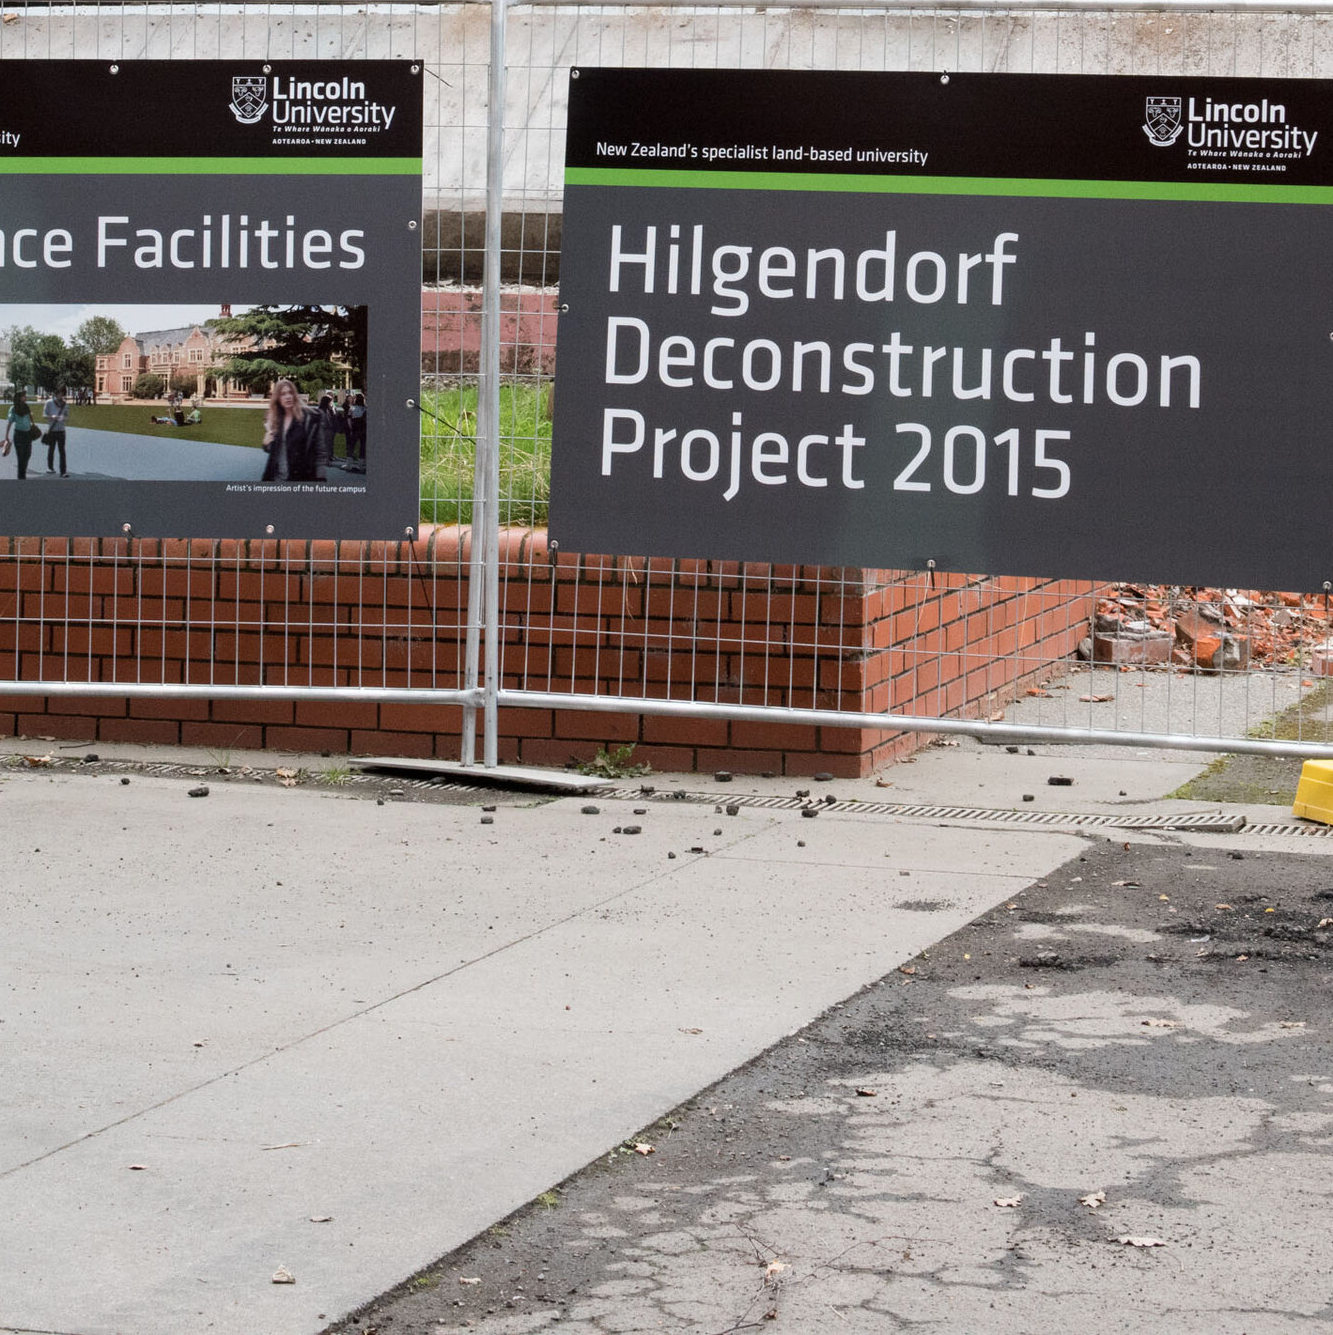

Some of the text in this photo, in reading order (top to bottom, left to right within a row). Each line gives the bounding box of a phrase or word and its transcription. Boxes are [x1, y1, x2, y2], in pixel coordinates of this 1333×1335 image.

[272, 76, 365, 100] Lincoln
[272, 100, 396, 130] University
[1188, 97, 1285, 123] Lincoln
[272, 125, 282, 133] Te
[283, 125, 310, 133] Whare
[353, 125, 381, 133] Aoraki
[1187, 122, 1318, 156] University
[597, 142, 928, 166] New Zealand’s specialist land-based university
[1186, 162, 1287, 172] AOTEAROA NEW ZEALAND
[1187, 149, 1198, 157] Te
[1199, 149, 1227, 157] Whare
[1272, 151, 1302, 159] Aoraki
[98, 214, 364, 269] Facilities
[608, 224, 1019, 317] Hilgendorf
[604, 316, 1201, 410] Deconstruction
[602, 408, 1070, 501] Project 2015
[252, 484, 292, 494] impression
[292, 484, 301, 493] of
[301, 484, 315, 493] the
[314, 484, 338, 493] future
[338, 486, 367, 495] campus
